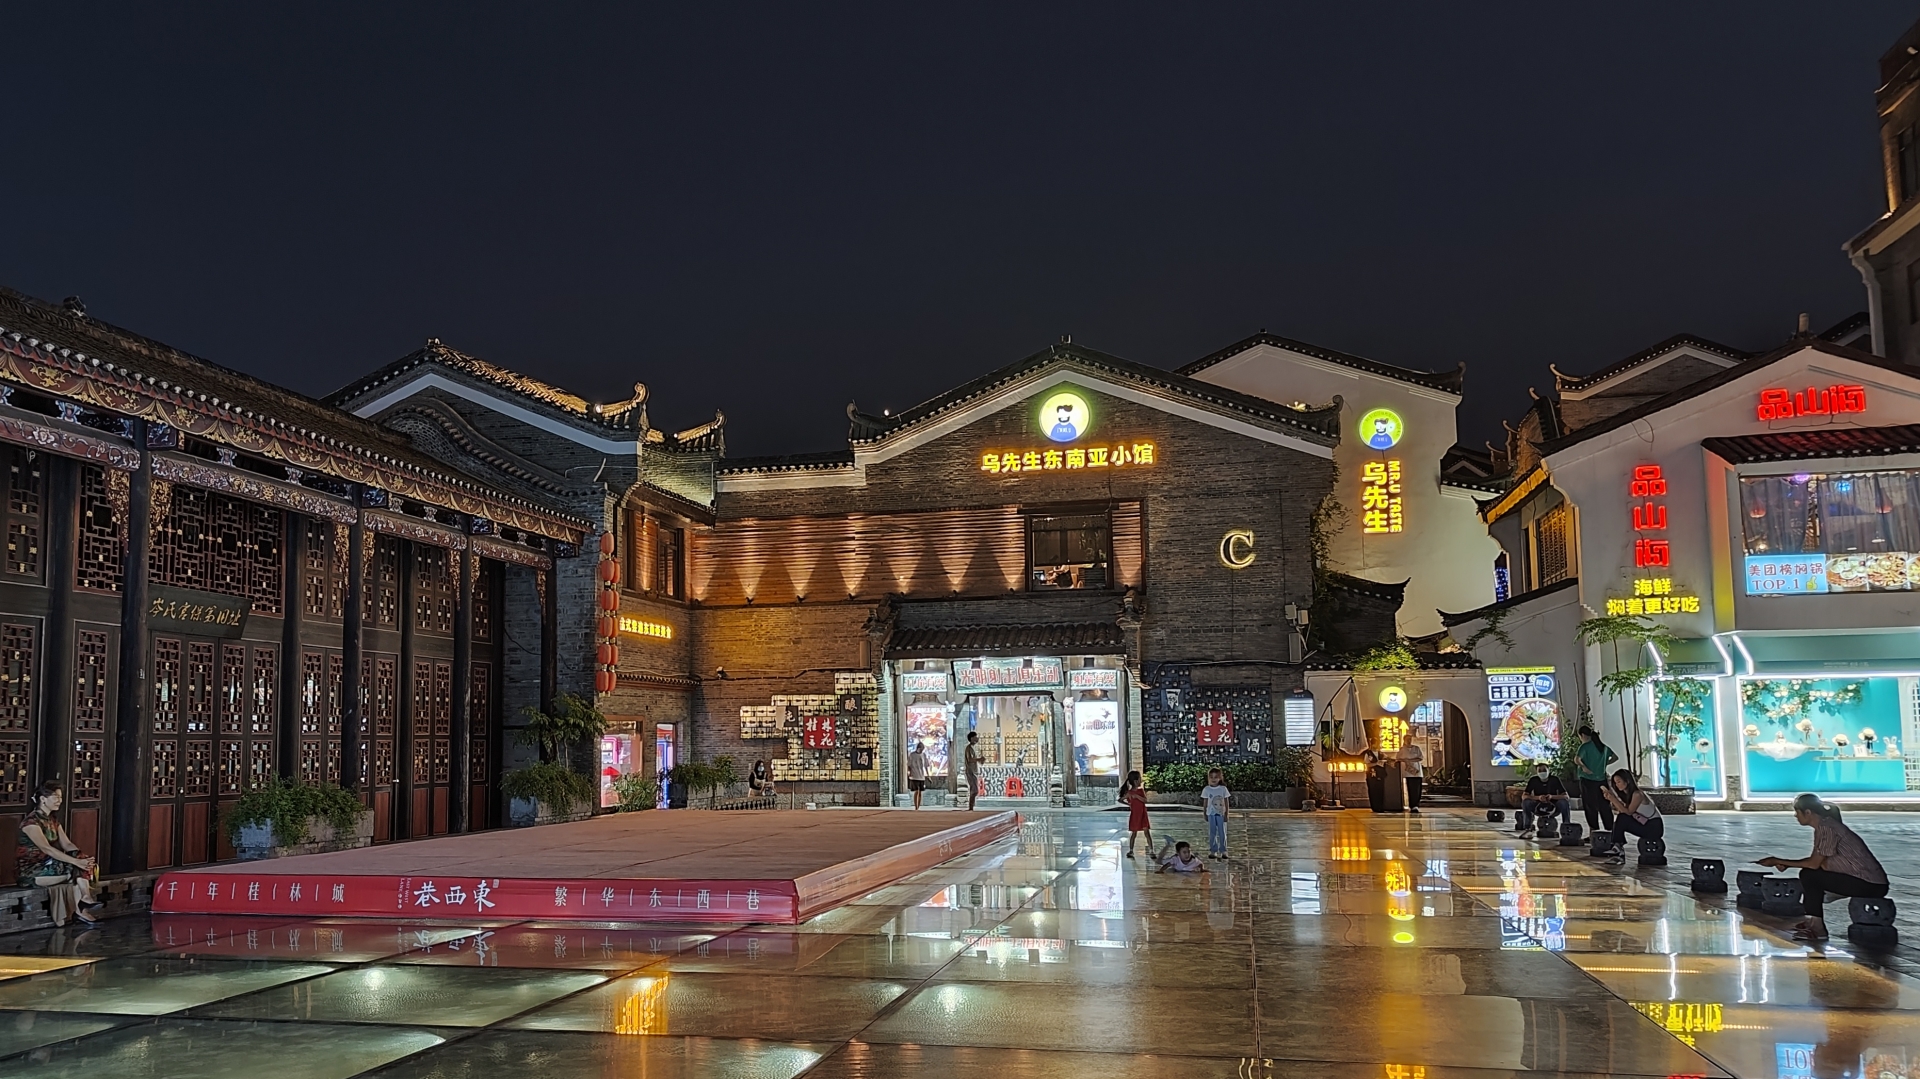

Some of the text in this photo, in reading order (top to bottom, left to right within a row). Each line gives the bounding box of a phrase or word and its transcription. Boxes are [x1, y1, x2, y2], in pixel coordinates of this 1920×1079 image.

[981, 443, 1154, 474] 乌先生东南亚小馆
[1362, 462, 1389, 534] 乌先生
[1388, 460, 1403, 533] MR.U TASTE
[1220, 530, 1256, 569] C
[1749, 562, 1824, 577] 美团榜焖锅
[1633, 578, 1672, 596] 海鲜
[1606, 597, 1700, 616] 焖着更好吃
[959, 665, 1059, 687] 光明射击俱乐部
[805, 717, 832, 732] 桂林
[1199, 711, 1230, 727] 桂林
[1202, 729, 1232, 744] 三花
